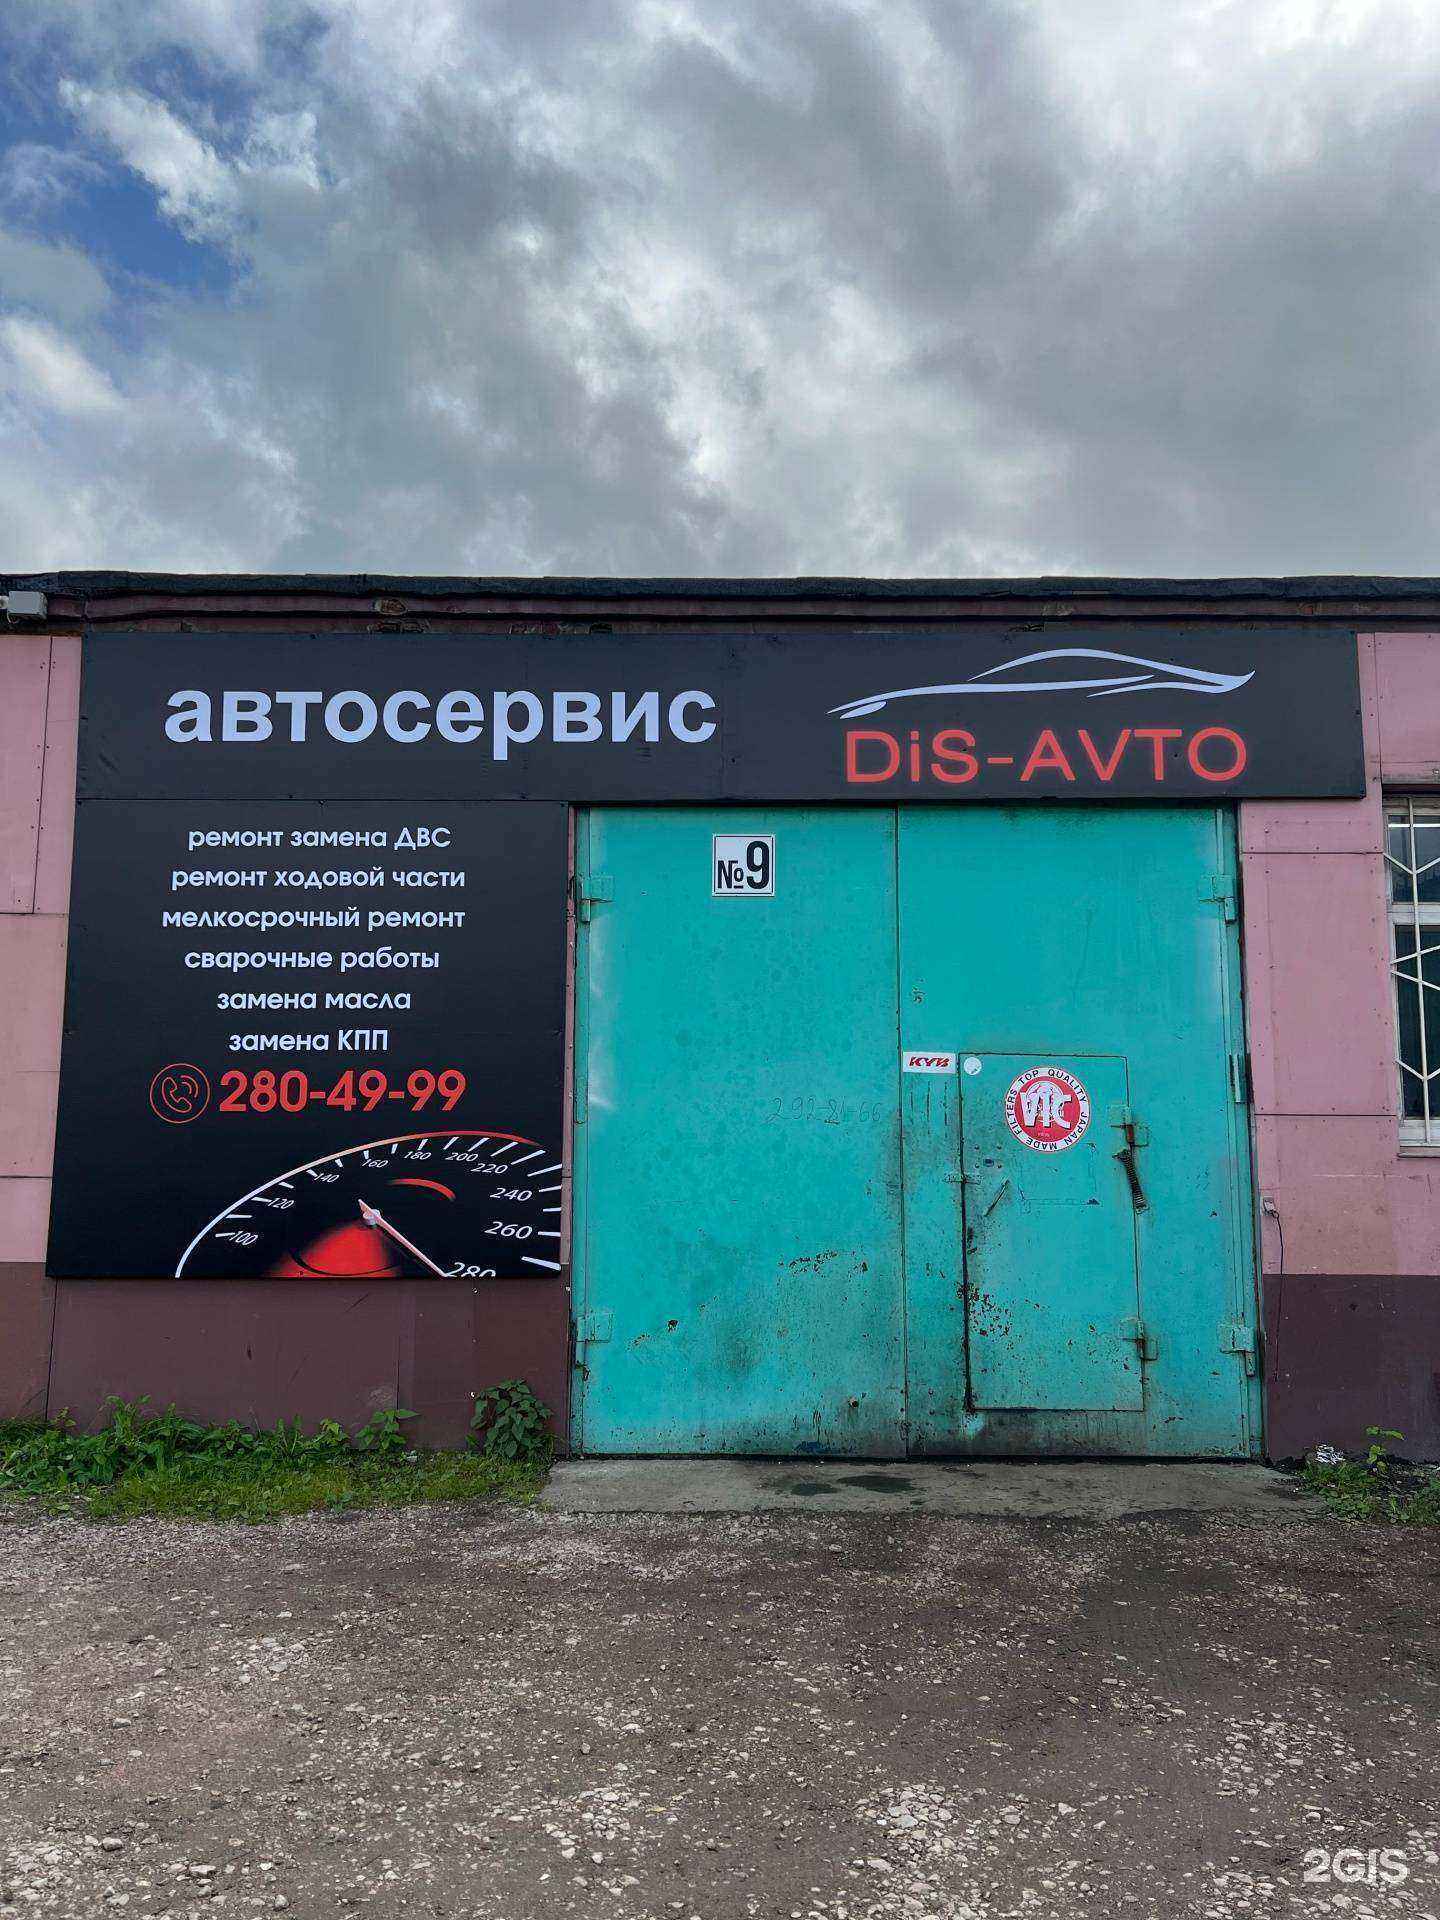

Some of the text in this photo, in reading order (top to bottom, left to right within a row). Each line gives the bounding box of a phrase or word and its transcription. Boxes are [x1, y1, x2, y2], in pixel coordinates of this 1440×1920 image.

[164, 690, 717, 760] автосервис
[845, 728, 1247, 783] DiS-AVTO
[188, 827, 451, 851] ремонт замена ДВС
[171, 866, 465, 890] ремонт ходовой части
[162, 906, 466, 931] мелкосрочный ремонт
[184, 946, 440, 973] сварочные работы
[217, 992, 411, 1010] замена масла
[228, 1030, 388, 1051] замена КПП
[909, 1056, 950, 1068] KYB
[1018, 1069, 1039, 1085] TOP
[1047, 1069, 1087, 1102] QUALITY
[220, 1069, 467, 1112] 280-49-99
[1006, 1089, 1023, 1135] FILTERS
[1064, 1111, 1088, 1146] JAPAN
[1025, 1137, 1058, 1150] MADE
[362, 1159, 389, 1168] 160
[402, 1151, 432, 1160] 180
[445, 1152, 479, 1162] 200
[313, 1172, 340, 1183] 140
[470, 1163, 508, 1174] 220
[489, 1187, 533, 1201] 240
[228, 1230, 258, 1245] 100
[484, 1221, 533, 1239] 260
